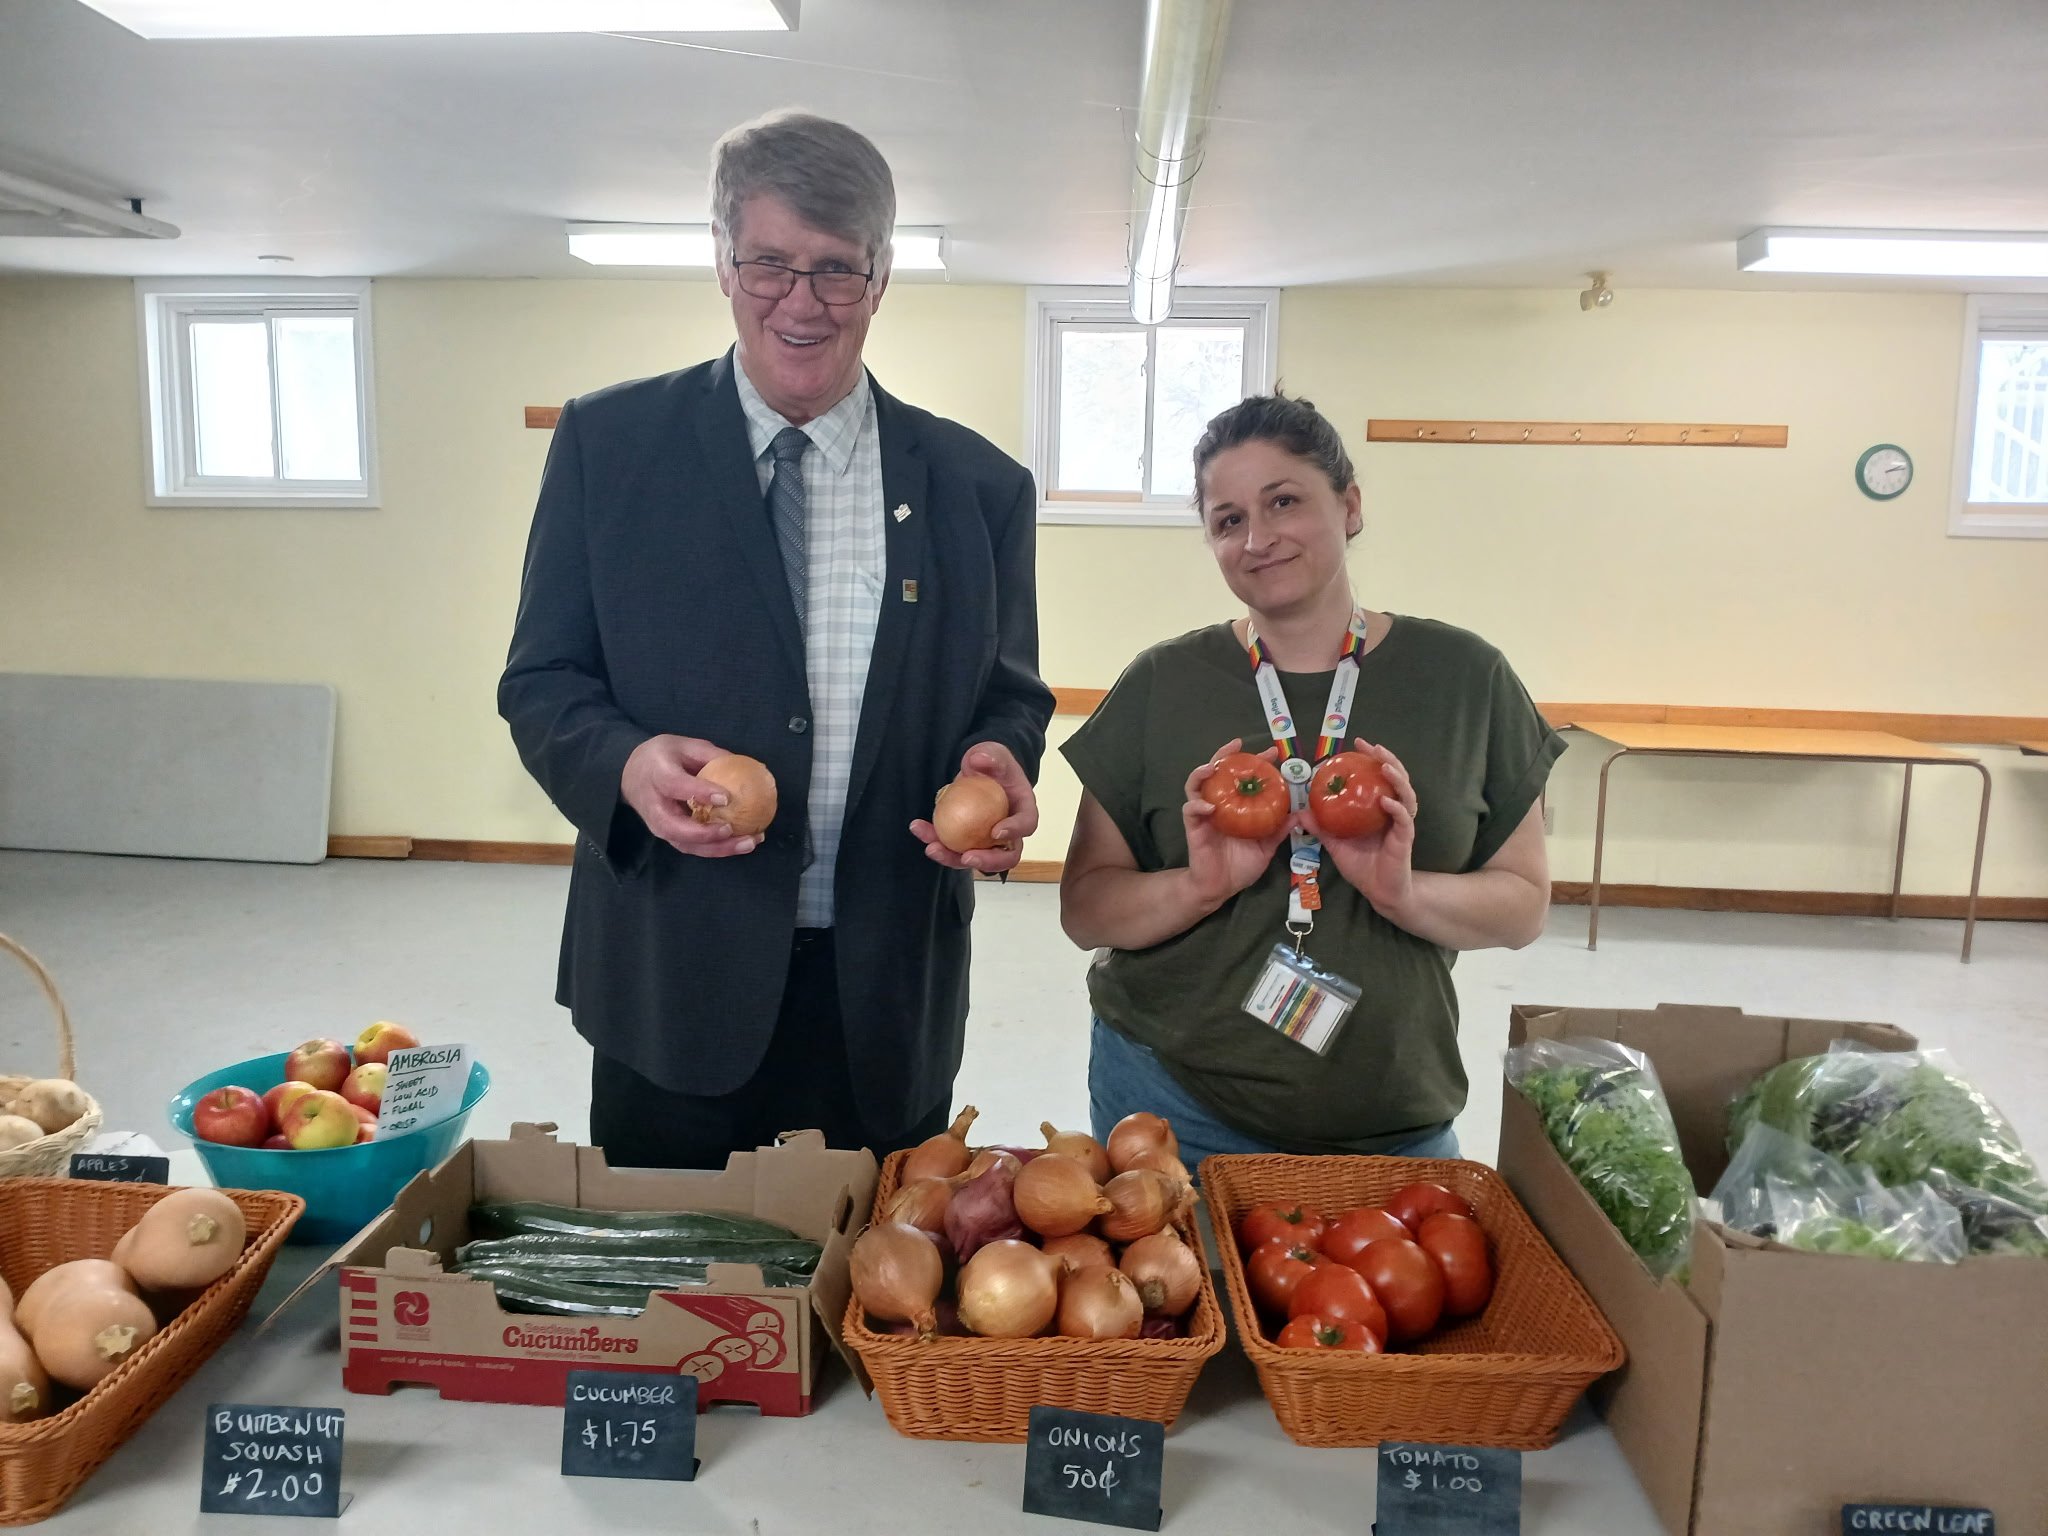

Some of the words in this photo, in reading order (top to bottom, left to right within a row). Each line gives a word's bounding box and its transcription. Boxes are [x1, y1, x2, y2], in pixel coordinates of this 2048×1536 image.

[388, 1049, 461, 1073] AMBROSIA
[393, 1093, 413, 1103] LOW
[415, 1086, 439, 1098] ACID
[395, 1076, 426, 1092] SWEET
[391, 1101, 425, 1115] FLORAL
[77, 1159, 129, 1172] APPLES
[502, 1326, 639, 1353] Cucumbers
[573, 1385, 676, 1405] CUCUMBER
[215, 1411, 345, 1438] BUTTERNUT
[581, 1418, 657, 1449] $1.75
[222, 1442, 323, 1465] SQUASH
[1048, 1426, 1142, 1458] ONIONS
[1382, 1446, 1480, 1471] TOMATO
[218, 1468, 323, 1501] $2.00
[1062, 1460, 1121, 1499] 50¢
[1402, 1469, 1483, 1493] $1.00
[1851, 1507, 1932, 1531] GREEN
[1938, 1511, 1993, 1534] LEAF
